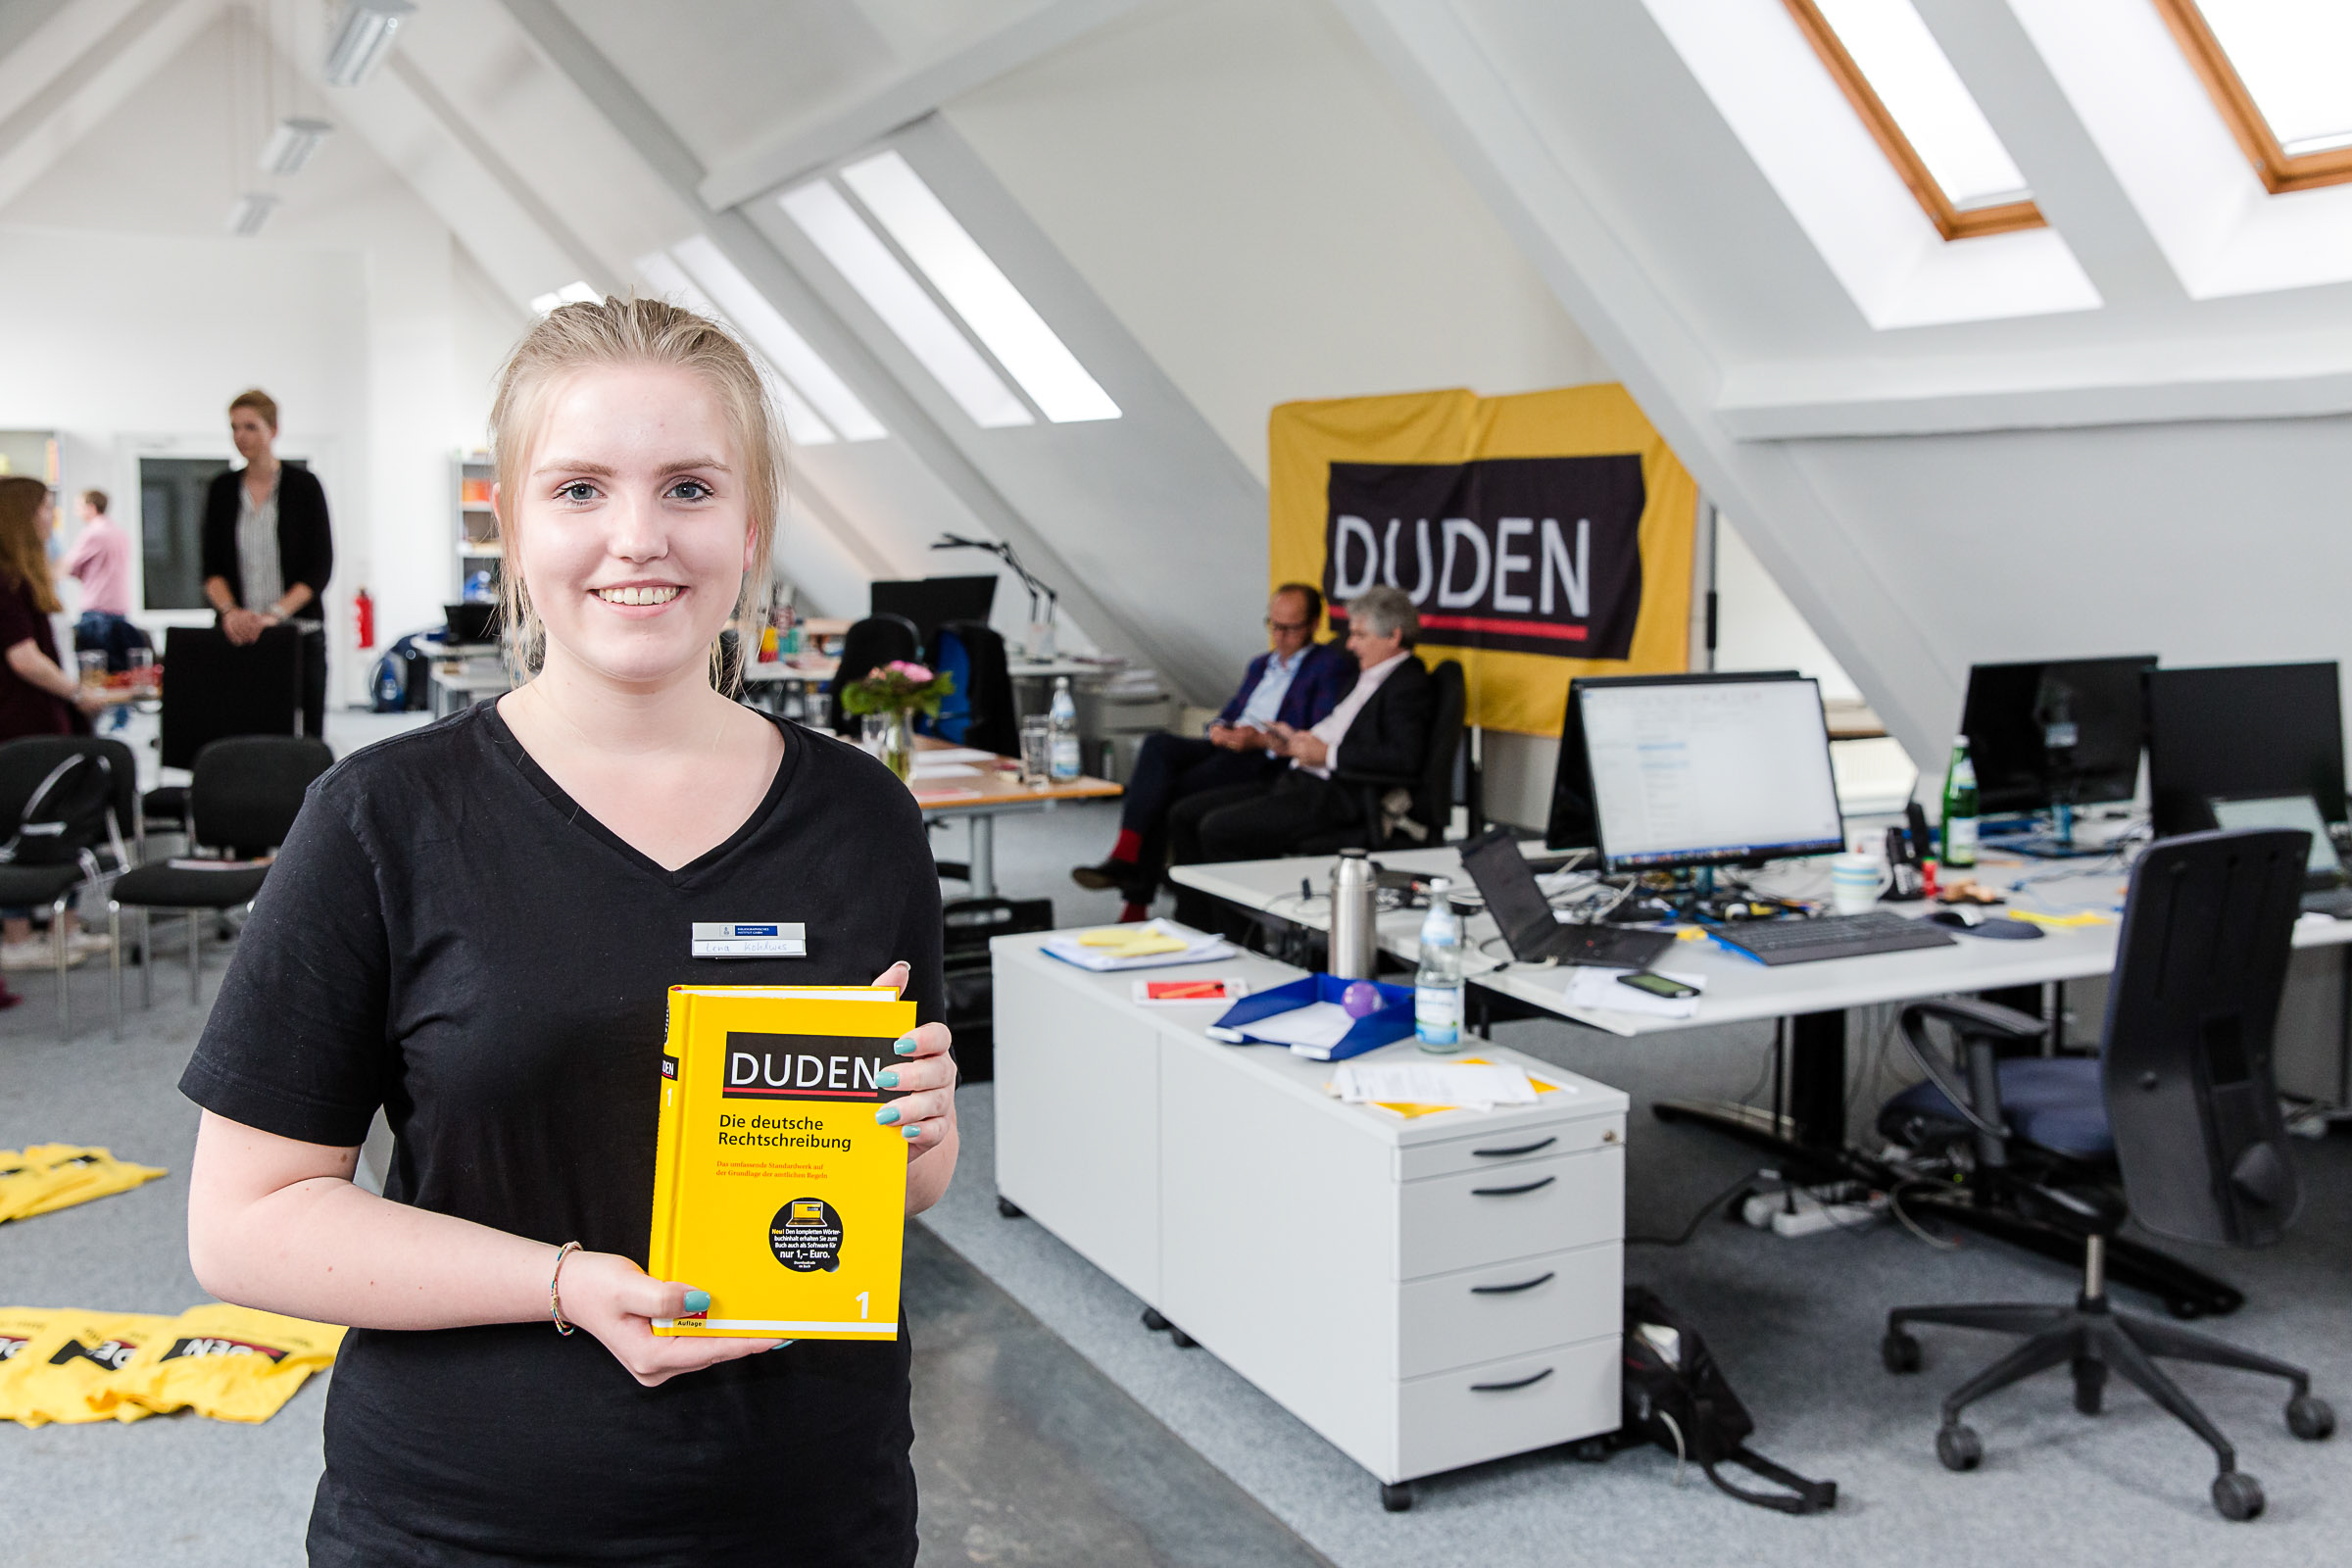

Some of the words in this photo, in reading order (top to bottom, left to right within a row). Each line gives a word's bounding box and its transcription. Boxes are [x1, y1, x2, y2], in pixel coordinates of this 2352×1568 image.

[1334, 515, 1590, 617] DUDEN
[731, 1052, 881, 1090] DUDEN
[667, 1088, 672, 1107] 1
[719, 1114, 746, 1128] Die
[751, 1115, 823, 1130] deutsche
[718, 1132, 852, 1152] Rechtschreibung
[809, 1250, 830, 1258] Euro.
[856, 1291, 869, 1319] 1
